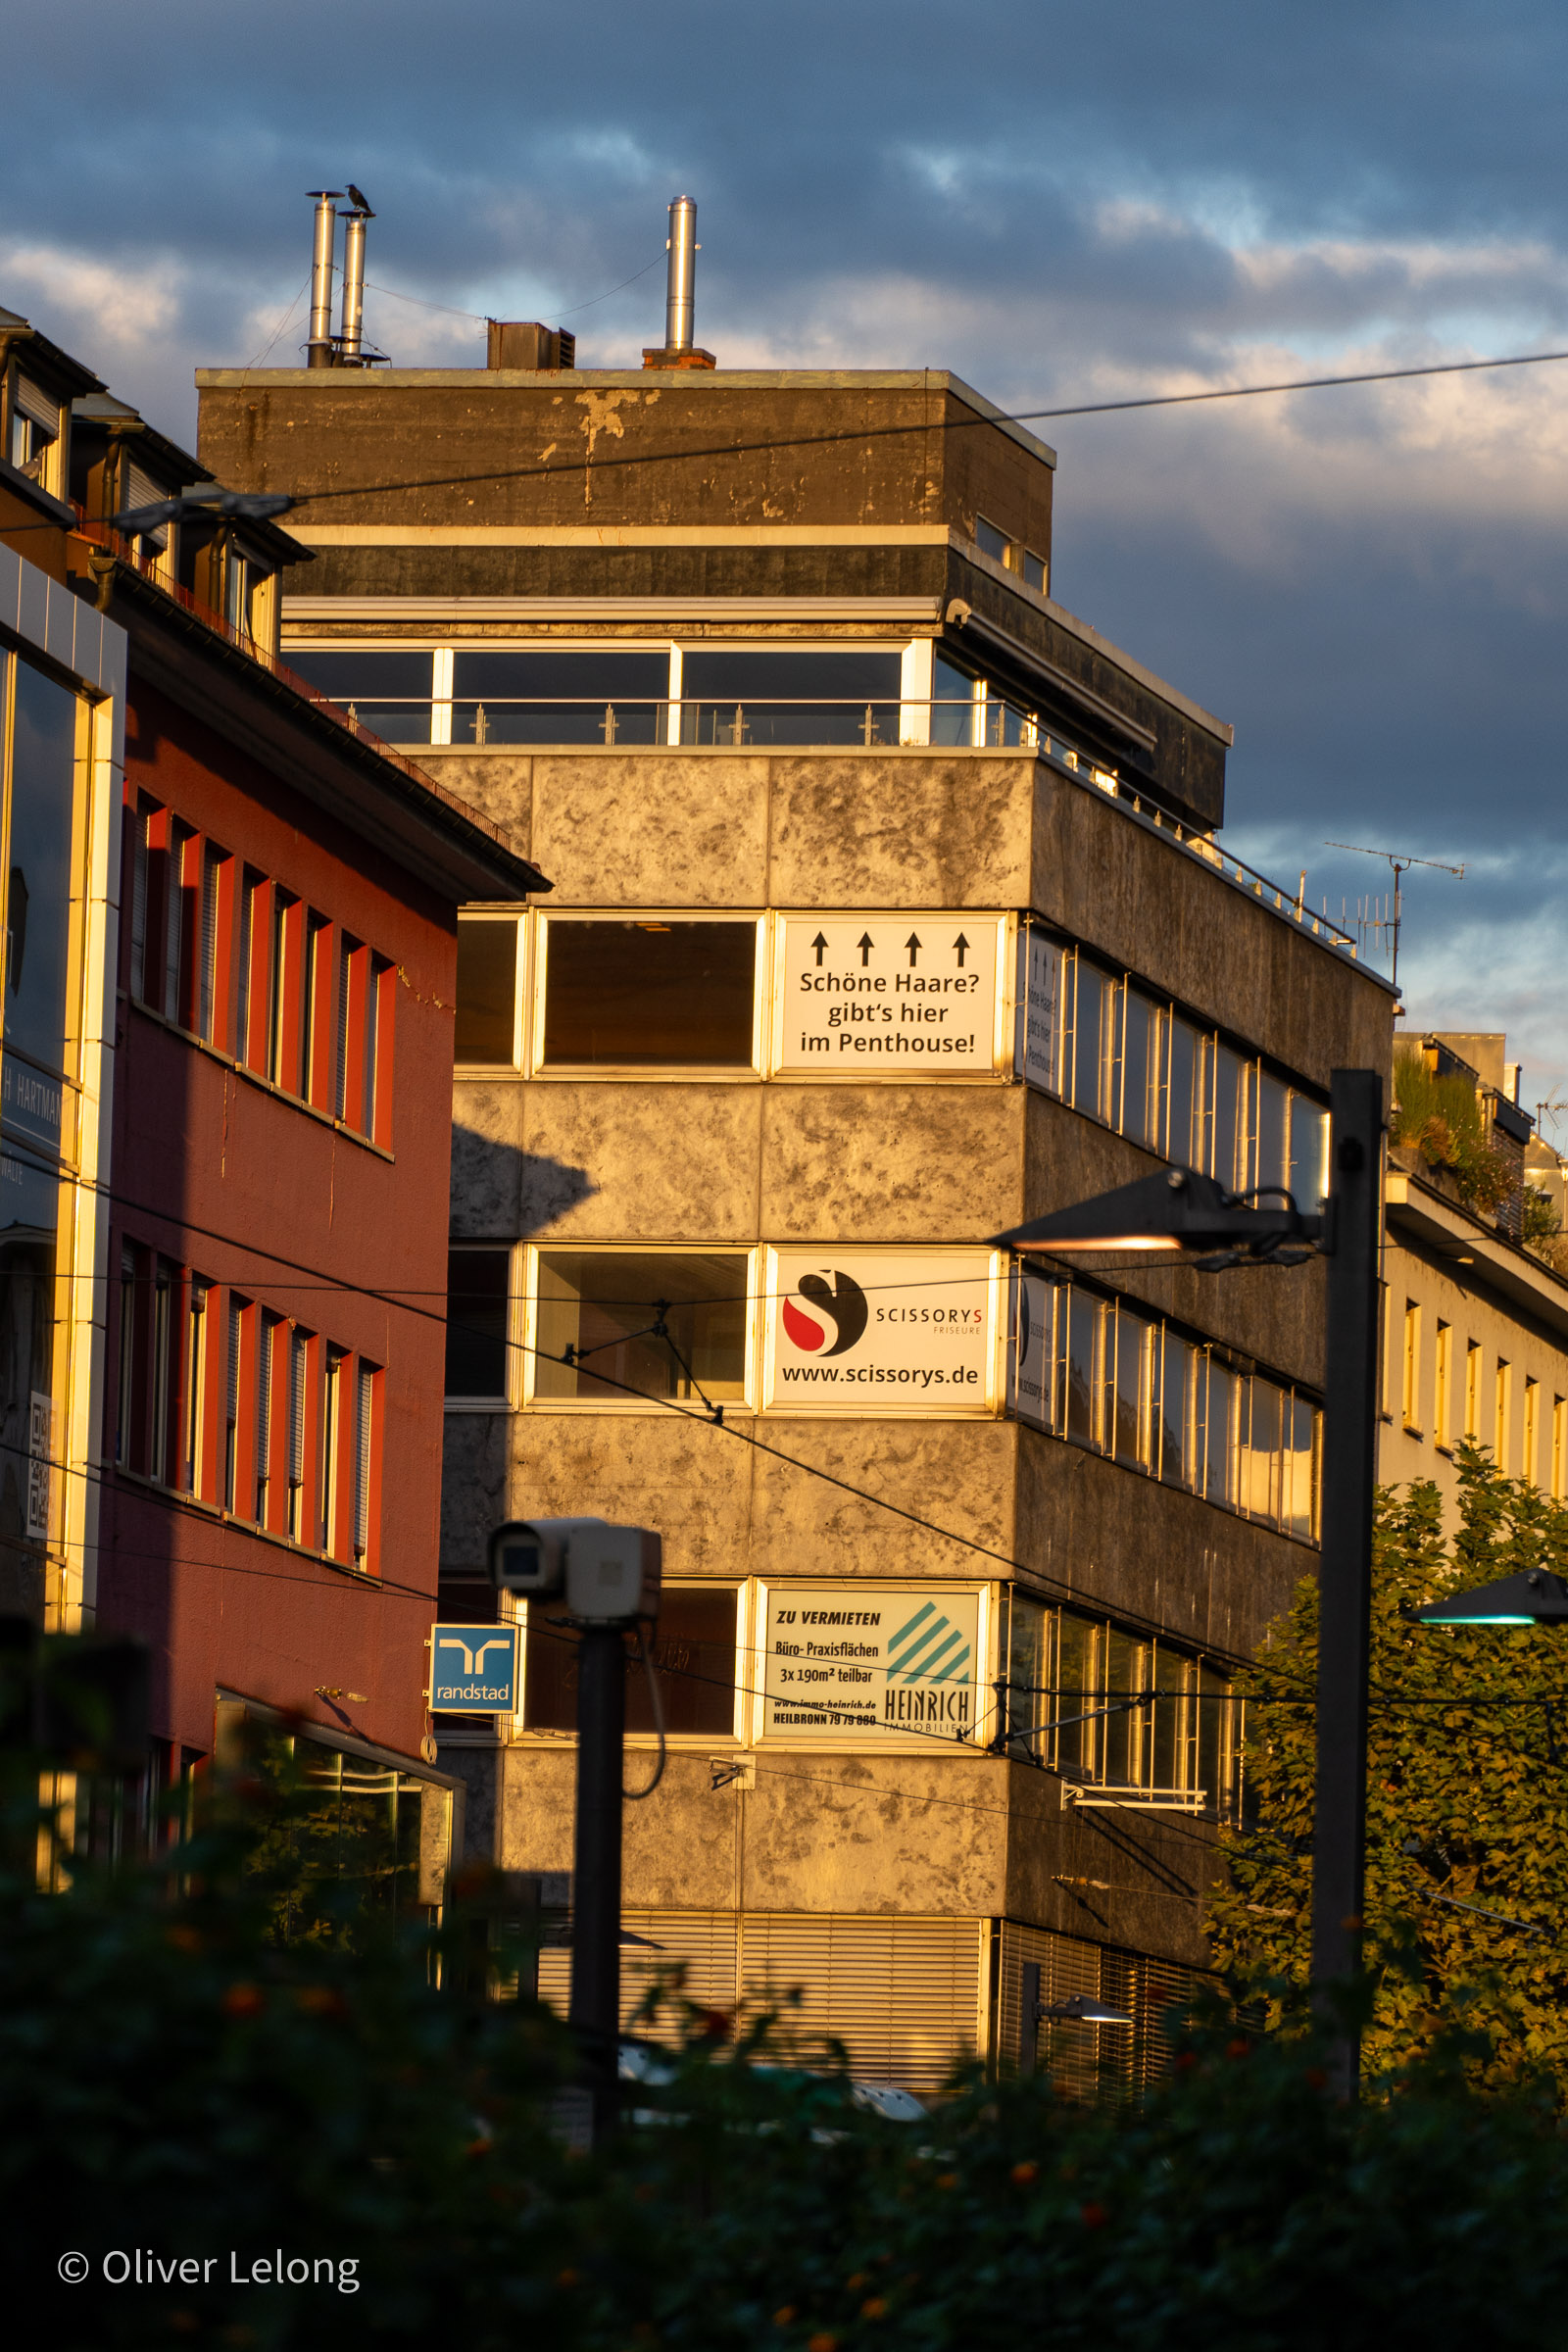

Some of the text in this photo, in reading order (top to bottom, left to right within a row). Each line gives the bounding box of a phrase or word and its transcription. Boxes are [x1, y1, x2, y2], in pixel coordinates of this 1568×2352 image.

[800, 971, 980, 993] Schöne Haare?
[901, 1003, 949, 1022] hier
[801, 1032, 975, 1053] im Penthouse!
[876, 1308, 982, 1323] SCISSORYS
[933, 1326, 981, 1335] FRISEURE
[782, 1364, 978, 1388] www.scissorys.de
[776, 1610, 881, 1626] ZU VERMIETEN
[775, 1642, 879, 1657] Büro- Praxisflächen
[780, 1667, 873, 1683] 3x 190m² teilbar
[436, 1682, 510, 1700] randstad
[885, 1690, 969, 1722] HEINRICH
[773, 1712, 827, 1725] HEILBRONN
[829, 1714, 840, 1725] 79
[843, 1714, 855, 1726] 79
